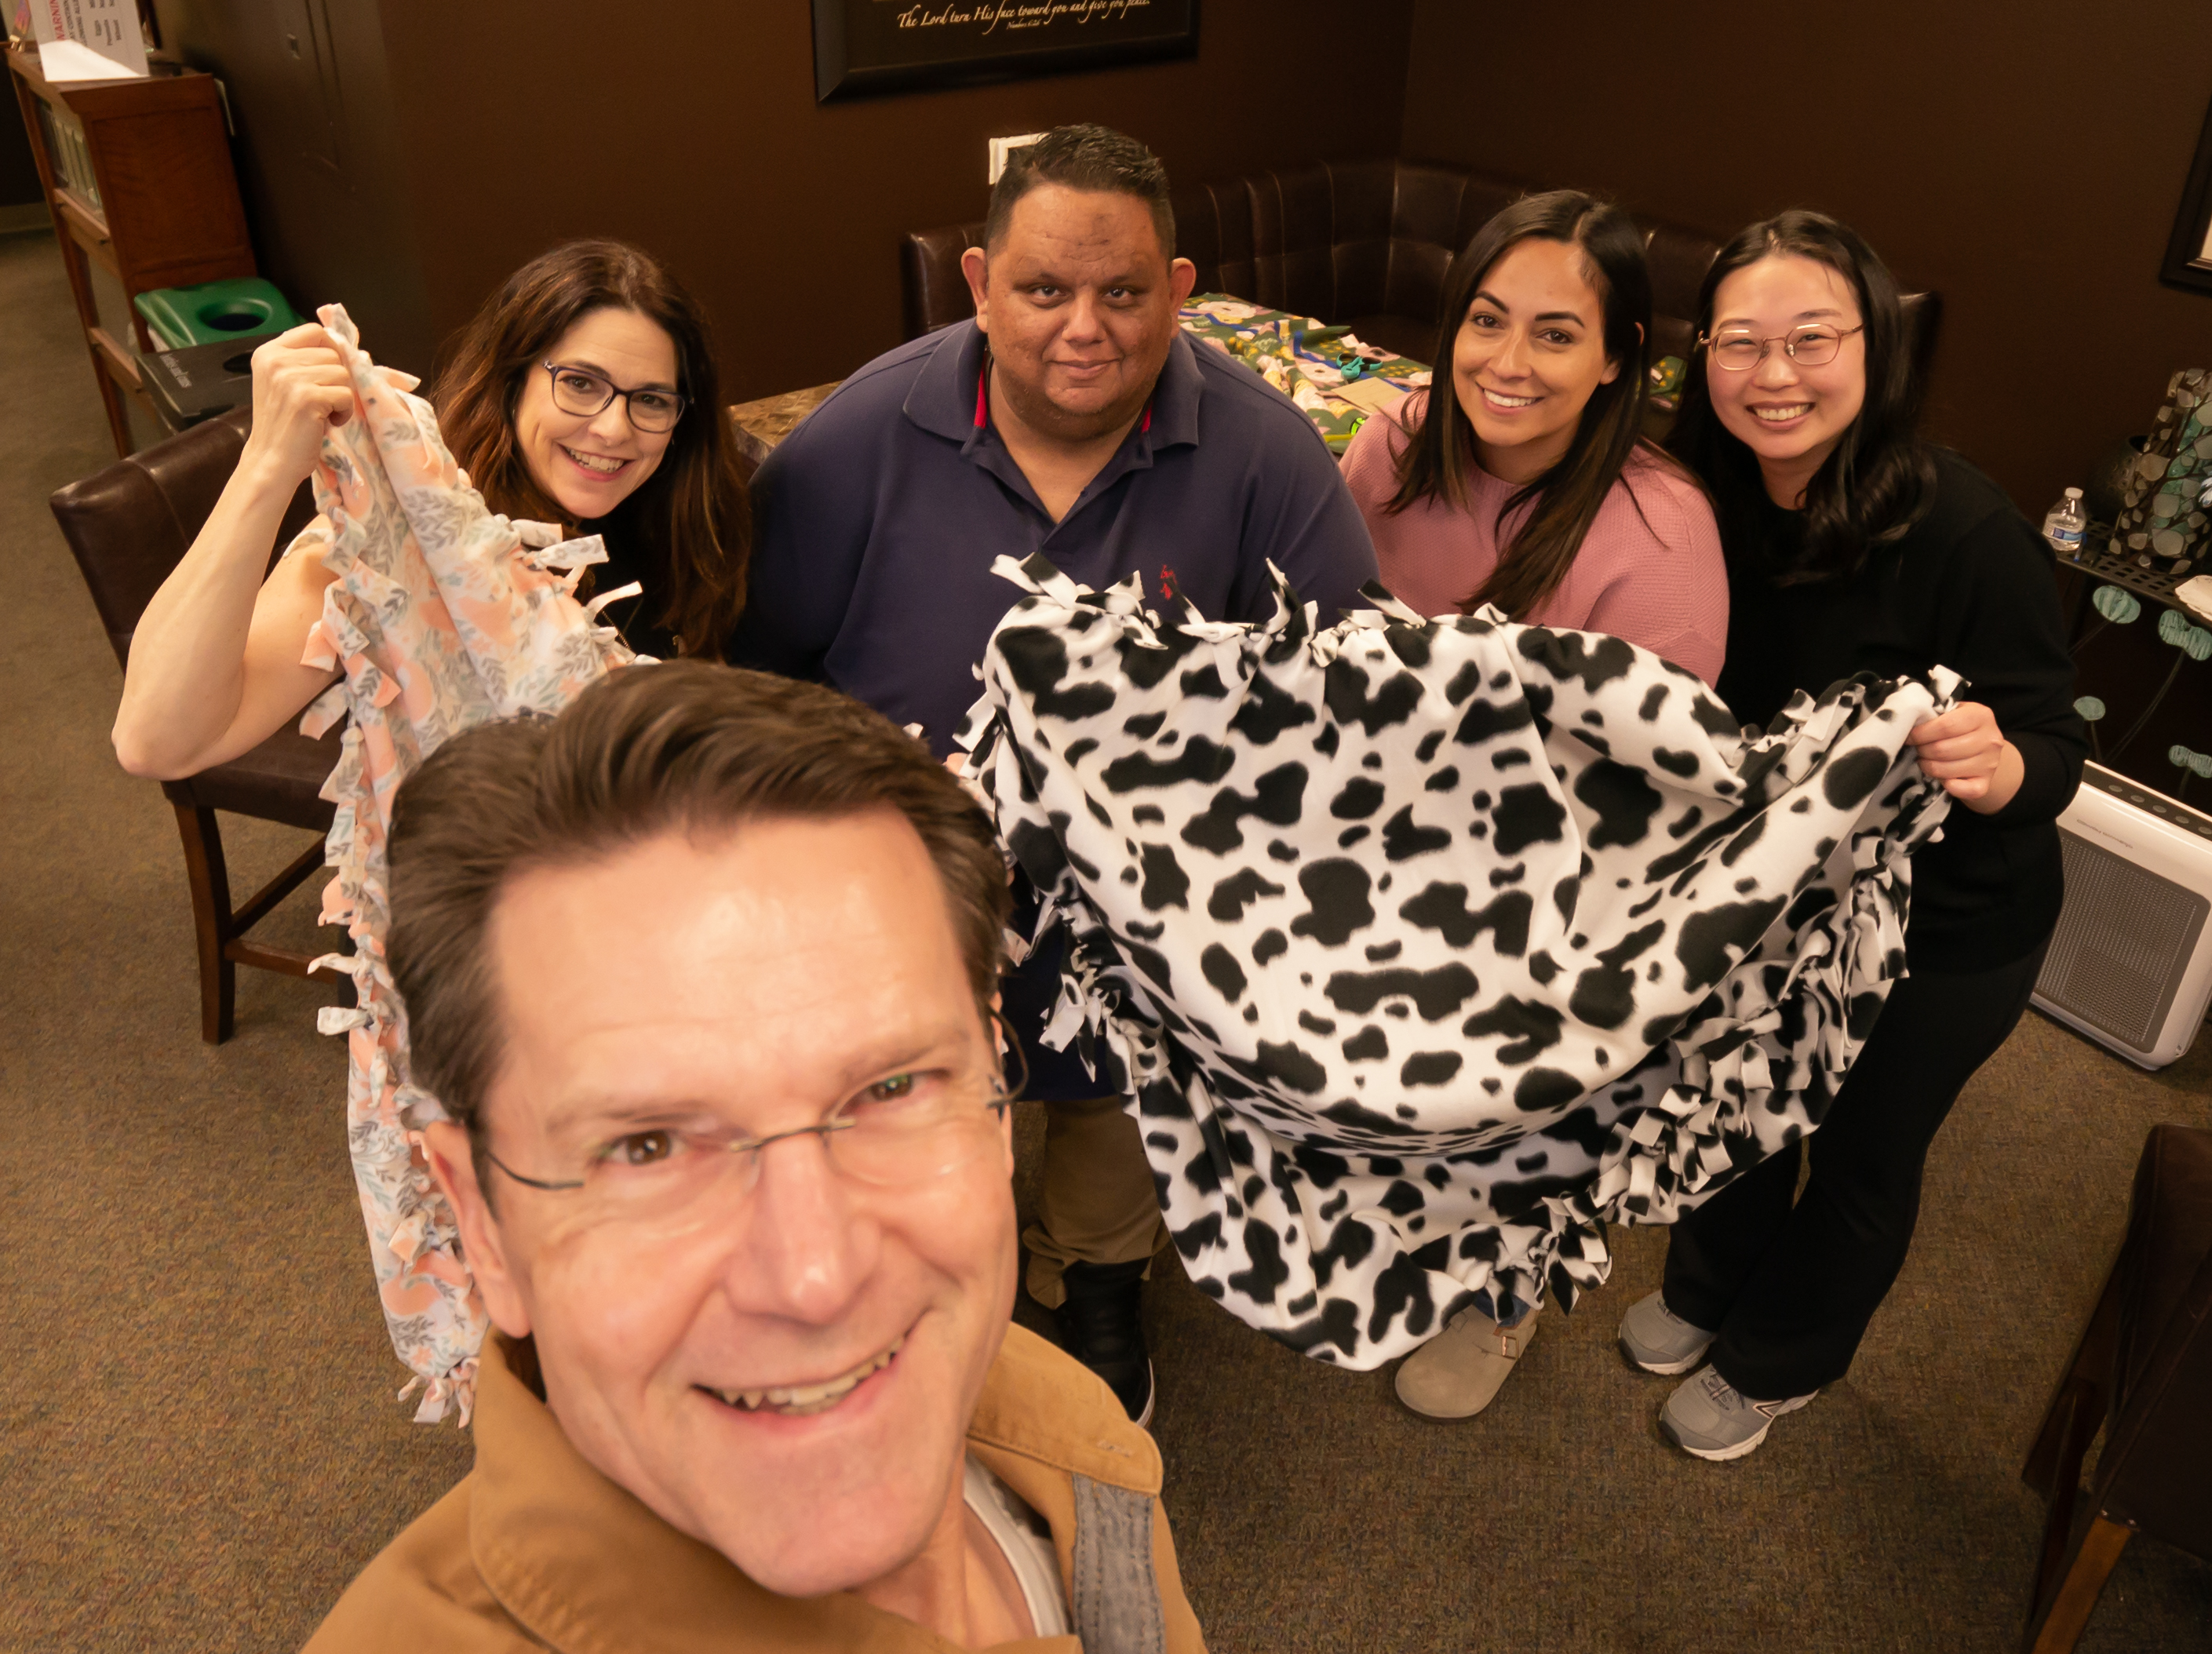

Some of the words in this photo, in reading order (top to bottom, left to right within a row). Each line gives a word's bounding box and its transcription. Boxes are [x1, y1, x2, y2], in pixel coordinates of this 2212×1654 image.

[897, 4, 921, 27] The
[920, 3, 954, 26] Lord
[974, 4, 994, 20] His
[1018, 0, 1051, 16] toward
[1044, 5, 1068, 24] you
[1070, 0, 1088, 12] and
[1077, 0, 1107, 24] give
[1101, 0, 1125, 20] you
[949, 11, 971, 23] turn
[982, 0, 1015, 35] face
